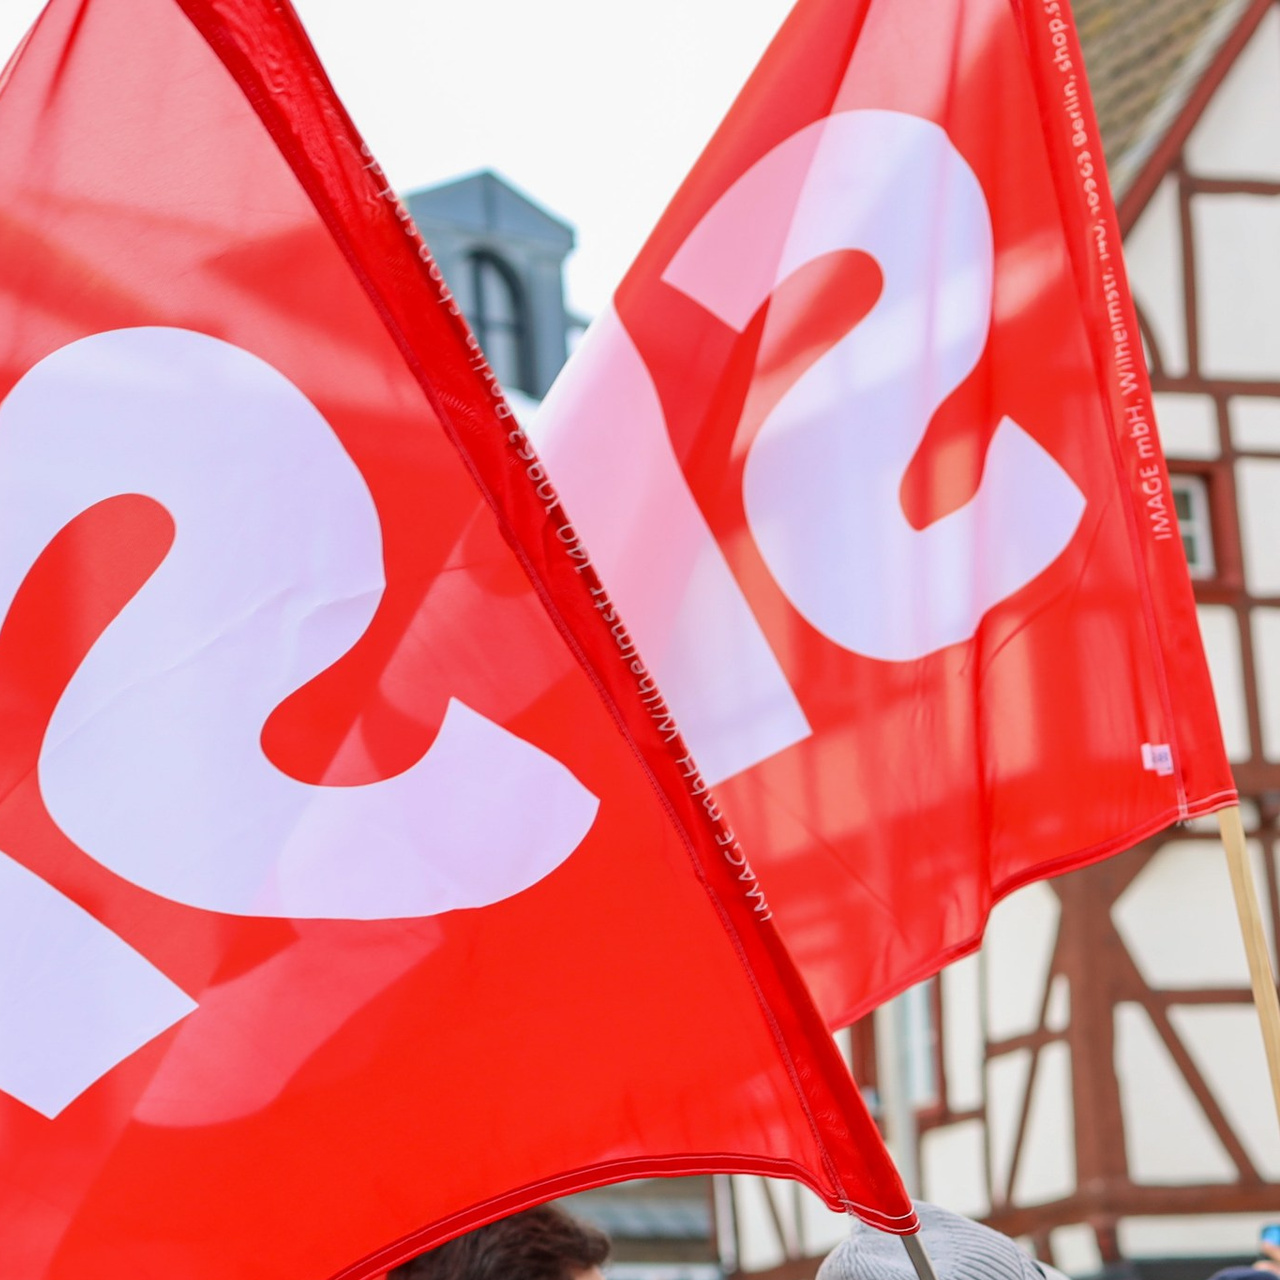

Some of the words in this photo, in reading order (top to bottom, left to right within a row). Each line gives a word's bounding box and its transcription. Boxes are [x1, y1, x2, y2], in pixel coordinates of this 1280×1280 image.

[1062, 75, 1088, 147] Berlin,
[1102, 266, 1139, 395] Wilhelmstr.
[1124, 398, 1155, 460] mbH,
[1140, 464, 1172, 541] IMAGE
[715, 828, 773, 922] IMAGE
